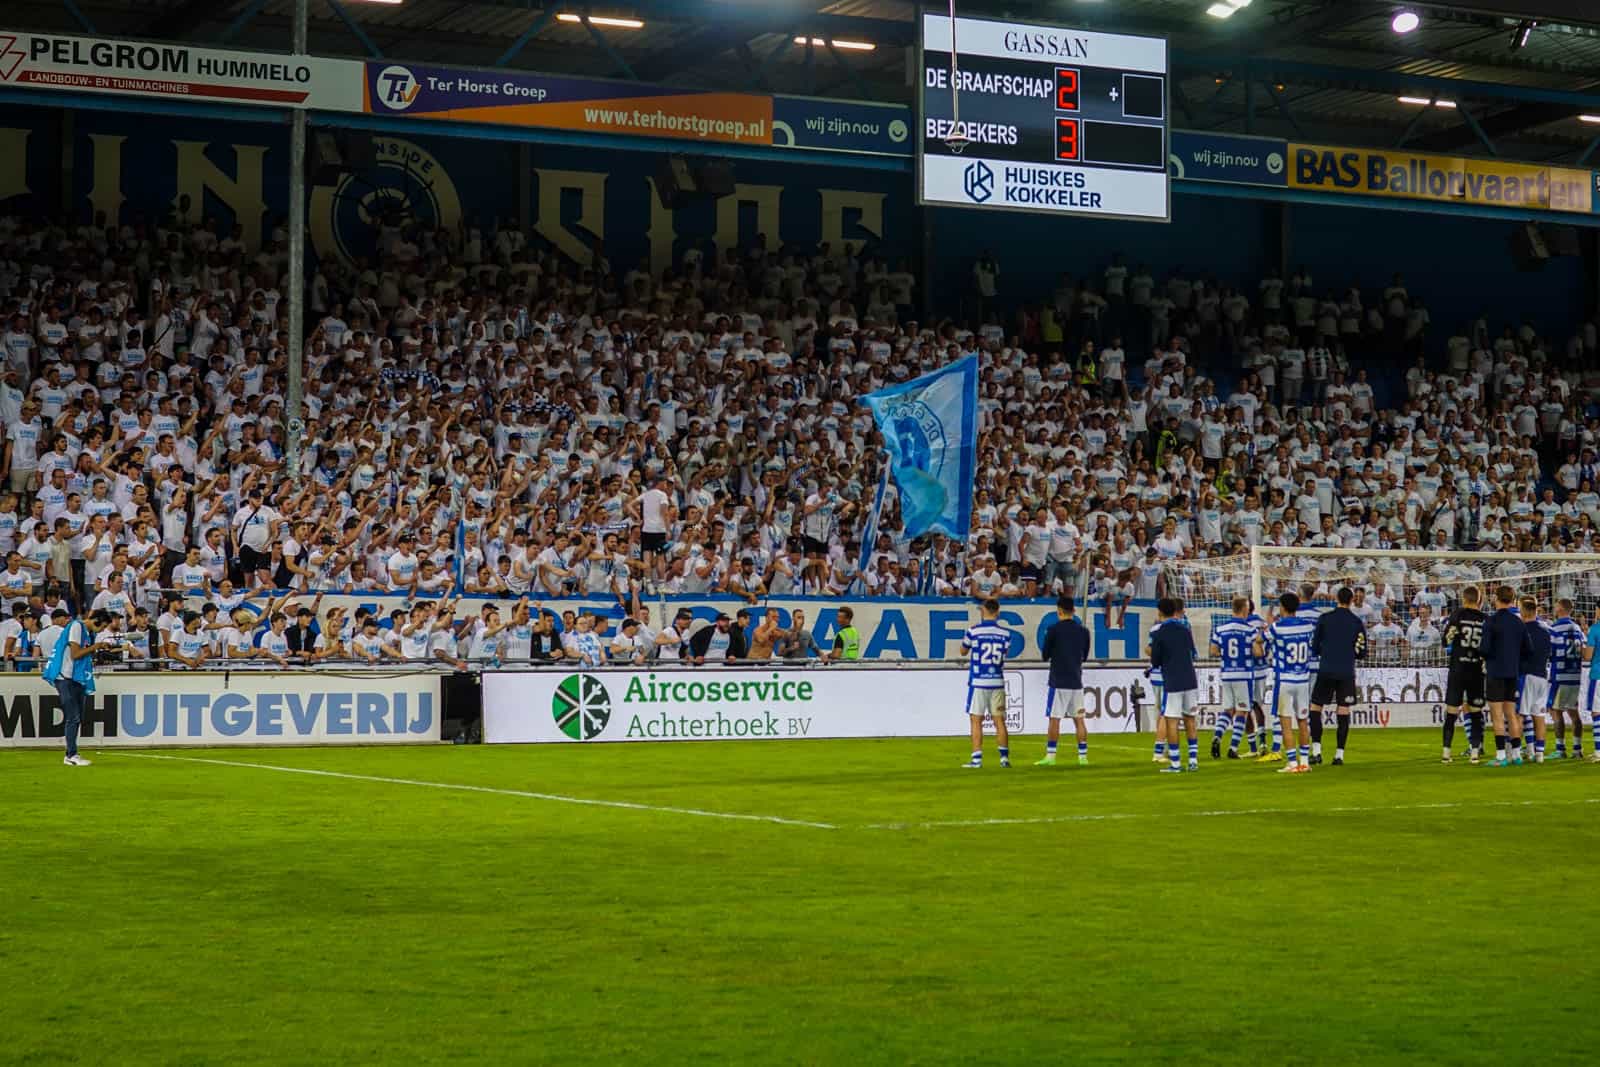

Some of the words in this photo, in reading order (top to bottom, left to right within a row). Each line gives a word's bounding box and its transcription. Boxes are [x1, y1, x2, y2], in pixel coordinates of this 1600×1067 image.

[1004, 31, 1088, 58] GASSAN
[30, 37, 189, 74] PELGROM
[197, 58, 311, 84] HUMMELO
[29, 72, 93, 87] LANDBOUW-
[95, 78, 110, 88] EN
[112, 79, 190, 95] TUINMACHINES
[427, 77, 454, 91] Ter
[458, 79, 498, 94] Horst
[503, 82, 547, 101] Groep
[926, 68, 947, 88] DE
[951, 70, 1054, 98] GRAAFSCHAP
[1058, 70, 1077, 110] 2
[584, 107, 765, 139] www.terhorstgroep.nl
[805, 117, 825, 135] wij
[926, 118, 1019, 145] BEZOEKERS
[1060, 119, 1078, 159] 3
[1192, 149, 1211, 167] wij
[1004, 166, 1086, 188] HUISKES
[1295, 148, 1361, 188] BAS
[1366, 154, 1585, 208] Ballonvaarten
[1004, 186, 1102, 208] KOKKELER
[1228, 638, 1239, 659] 6
[1461, 626, 1482, 649] 35
[980, 642, 1003, 665] 25
[1286, 642, 1309, 664] 30
[624, 673, 813, 702] Aircoservice
[626, 711, 780, 738] Achterhoek
[787, 717, 812, 736] BV
